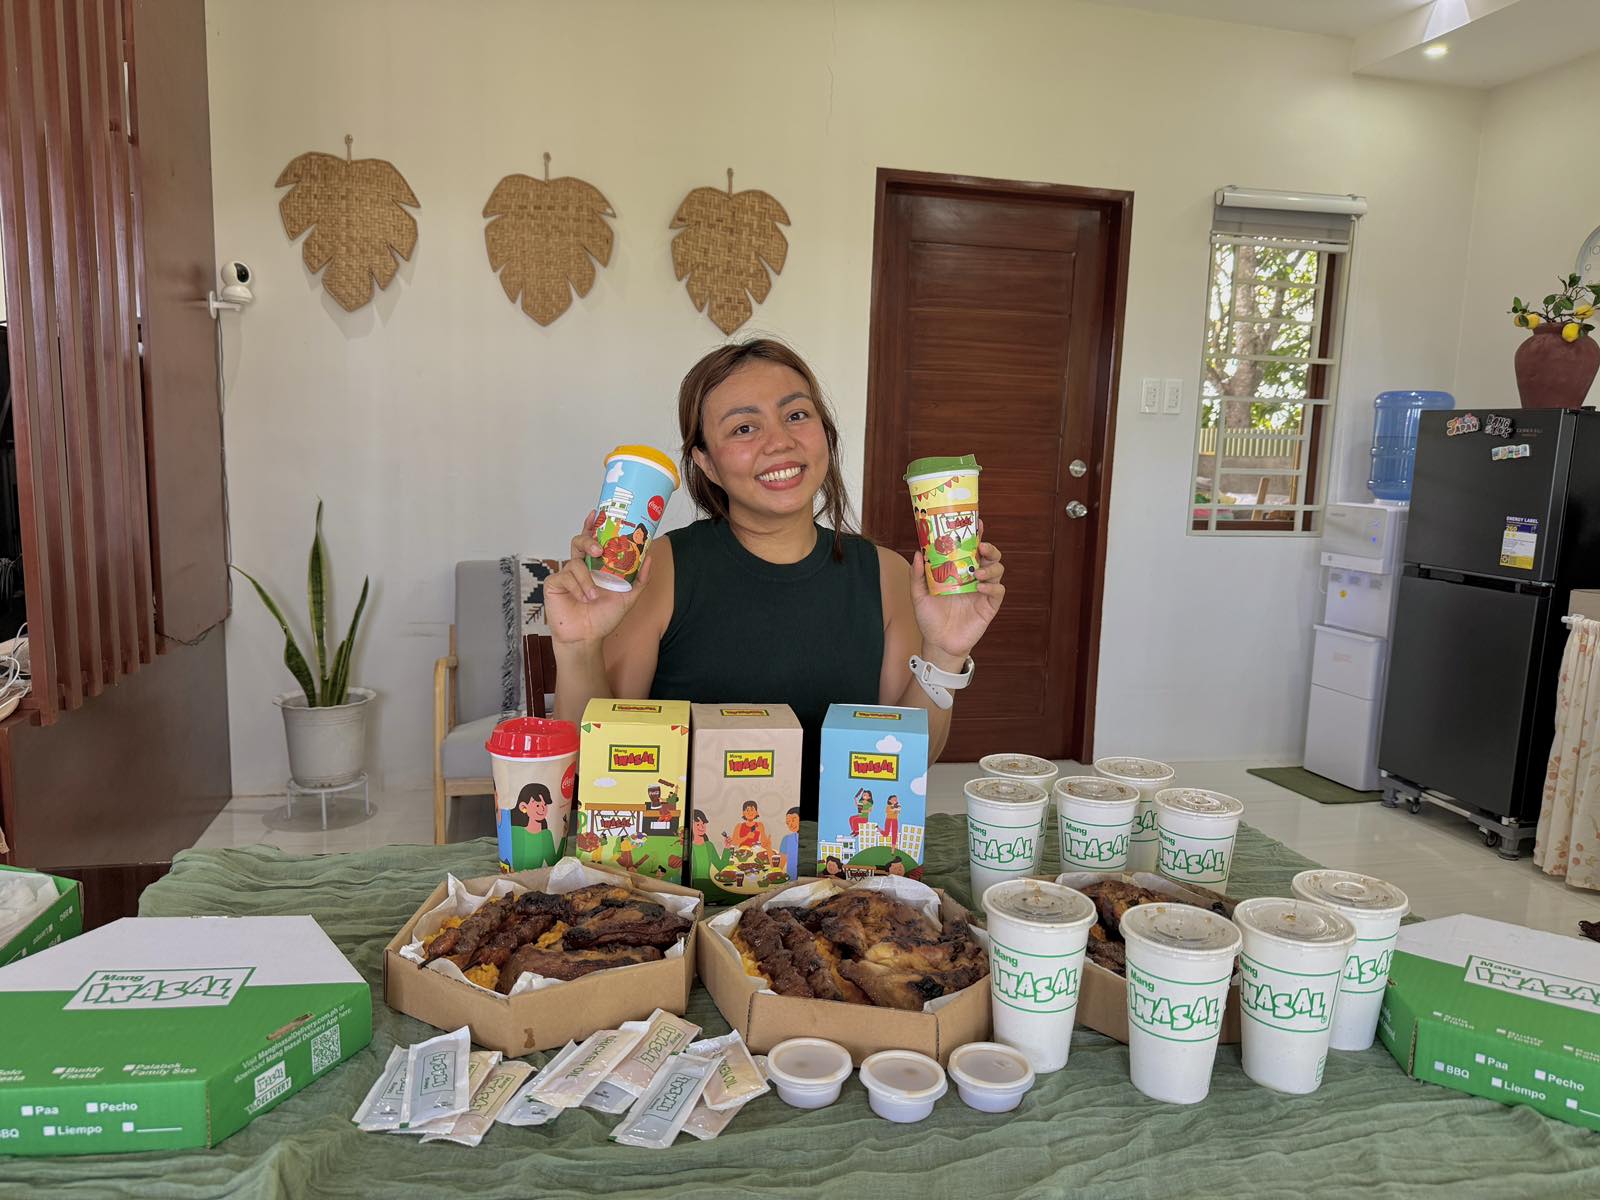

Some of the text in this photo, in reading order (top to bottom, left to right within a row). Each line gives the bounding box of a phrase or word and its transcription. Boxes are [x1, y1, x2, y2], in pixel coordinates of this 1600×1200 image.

[1447, 417, 1479, 436] JAPAN
[613, 751, 655, 767] INASAL
[728, 756, 769, 772] INASAL
[853, 759, 894, 773] INASAL
[1065, 822, 1088, 836] Mang
[969, 832, 1034, 863] INASAL
[993, 945, 1018, 967] Mang
[1480, 960, 1522, 975] Mang
[99, 974, 146, 983] Mang
[993, 958, 1078, 1003] INASAL
[1130, 968, 1155, 992] Mang
[83, 975, 233, 1004] INASAL
[1129, 982, 1219, 1031] INASAL
[302, 1022, 327, 1041] Delivery
[641, 1025, 677, 1064] INASAL
[565, 1035, 617, 1080] CHICKEN OIL
[1487, 1056, 1509, 1071] Paa
[432, 1053, 449, 1089] INASAL
[1446, 1065, 1470, 1079] BBQ
[1504, 1081, 1547, 1101] Liempo
[1548, 1073, 1585, 1092] Pecho
[256, 1079, 291, 1107] DELIVERY
[656, 1073, 691, 1112] INASAL
[34, 1102, 138, 1116] Paa Pecho
[0, 1125, 103, 1139] BQ Liempo
